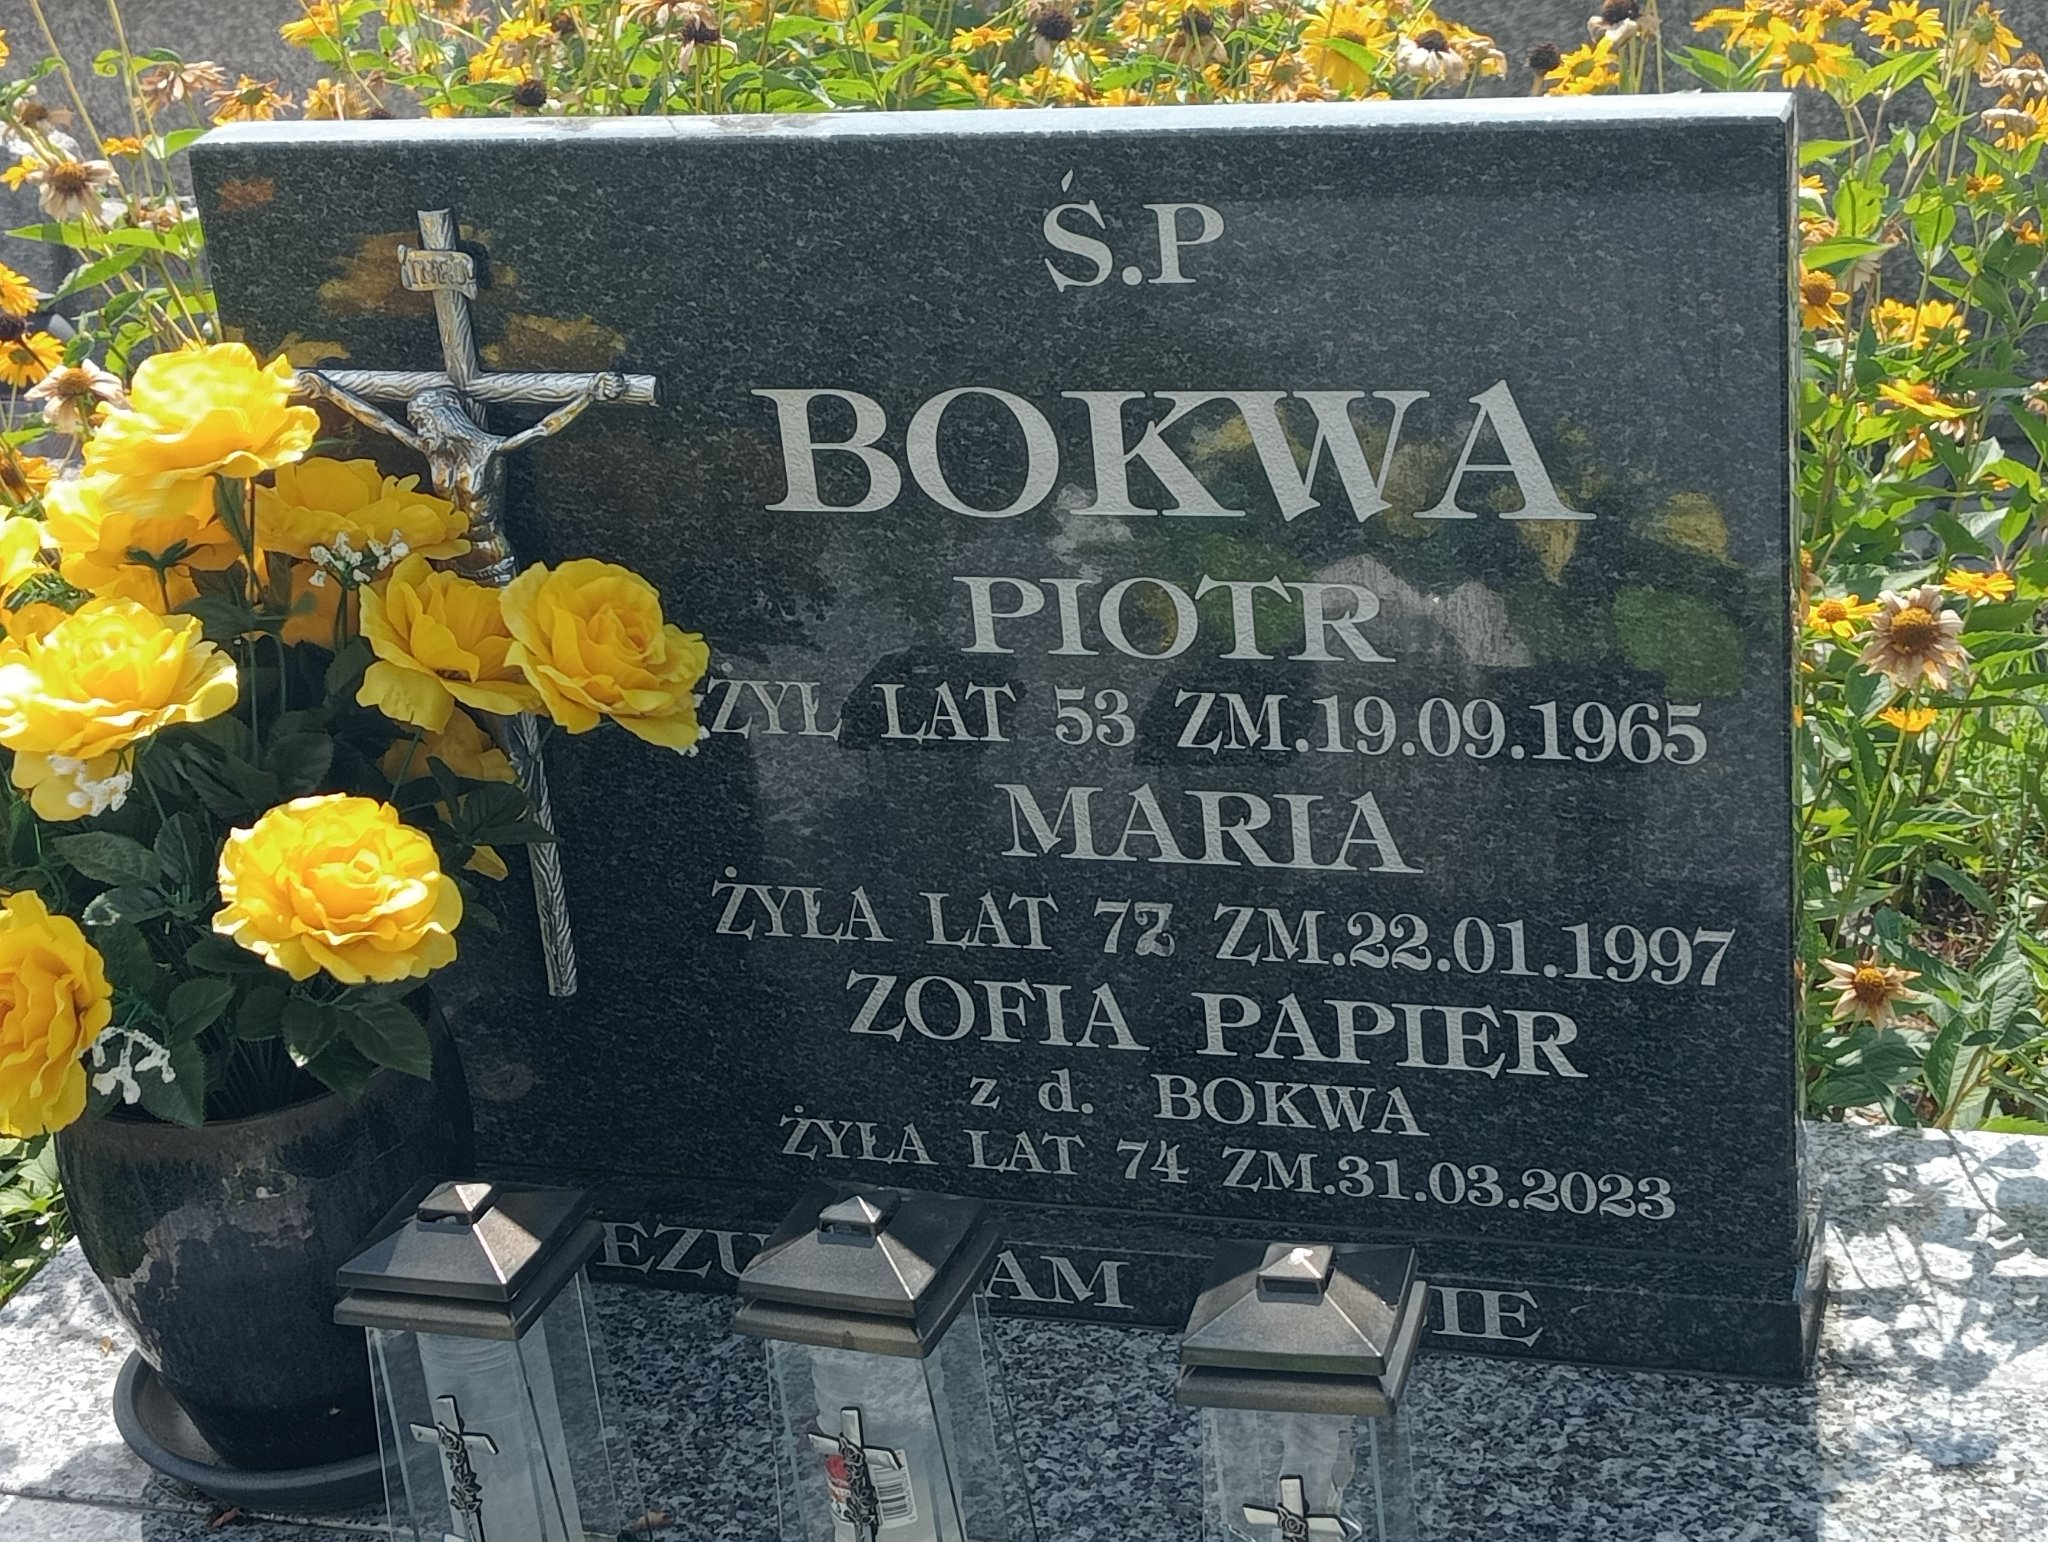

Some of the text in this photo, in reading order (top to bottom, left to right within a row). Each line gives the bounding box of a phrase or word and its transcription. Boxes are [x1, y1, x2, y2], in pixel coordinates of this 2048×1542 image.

[1043, 169, 1225, 292] Ś.P
[751, 379, 1597, 523] BOKWA
[952, 574, 1397, 664] PIOTR
[707, 662, 1708, 765] ŻYŁ LAT 53 ZM.19.09.1965
[994, 783, 1424, 874] MARIA
[711, 866, 893, 944] ŻYŁA
[919, 890, 1059, 951] LAT
[1214, 902, 1736, 987] ZM.22.01.1997
[846, 969, 1589, 1079] ZOFIA PAPIER
[969, 1068, 1430, 1136] z d. BOKWA
[779, 1105, 1676, 1220] ŻYŁA LAT 74 ZM.31.03.2023
[596, 1221, 771, 1279] EZU
